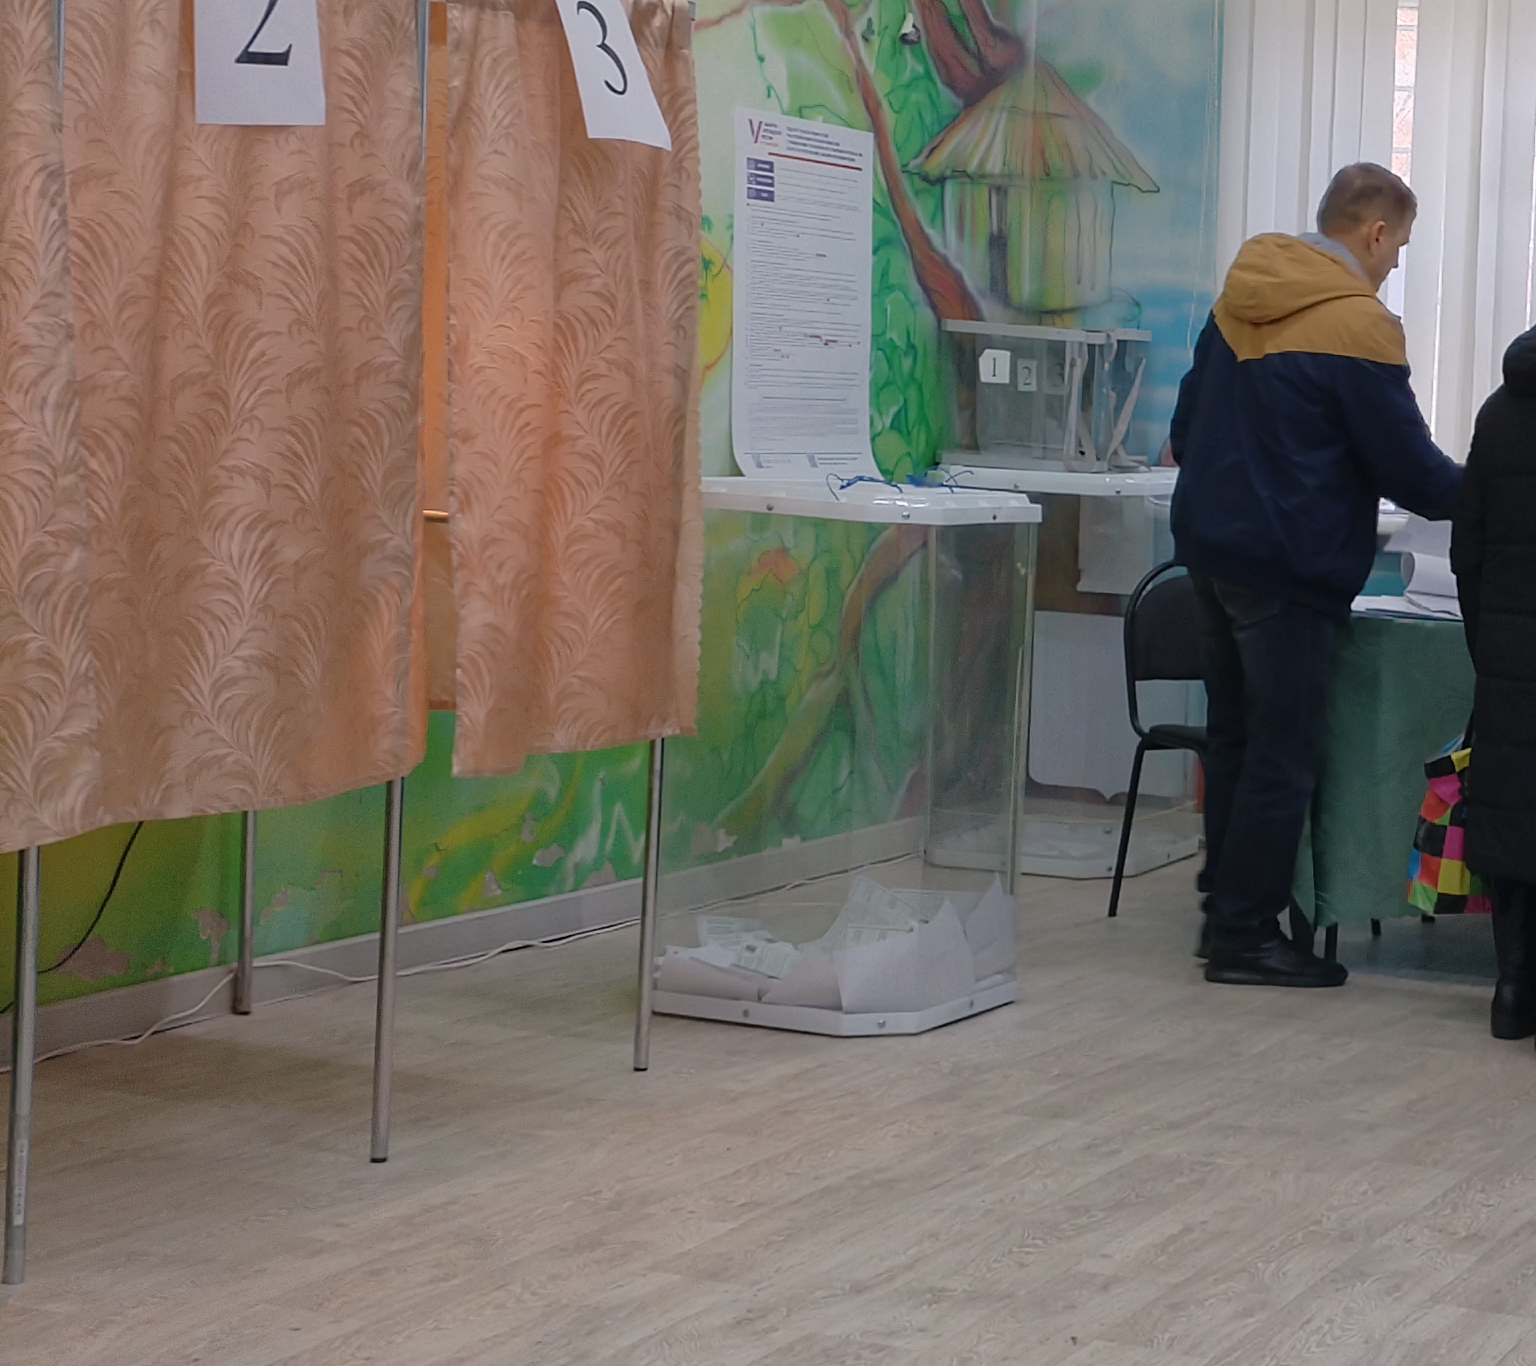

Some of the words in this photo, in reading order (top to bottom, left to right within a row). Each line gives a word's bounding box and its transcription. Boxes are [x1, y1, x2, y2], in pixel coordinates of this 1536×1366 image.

[575, 0, 629, 96] 3
[991, 357, 998, 377] 1
[1021, 365, 1032, 386] 2
